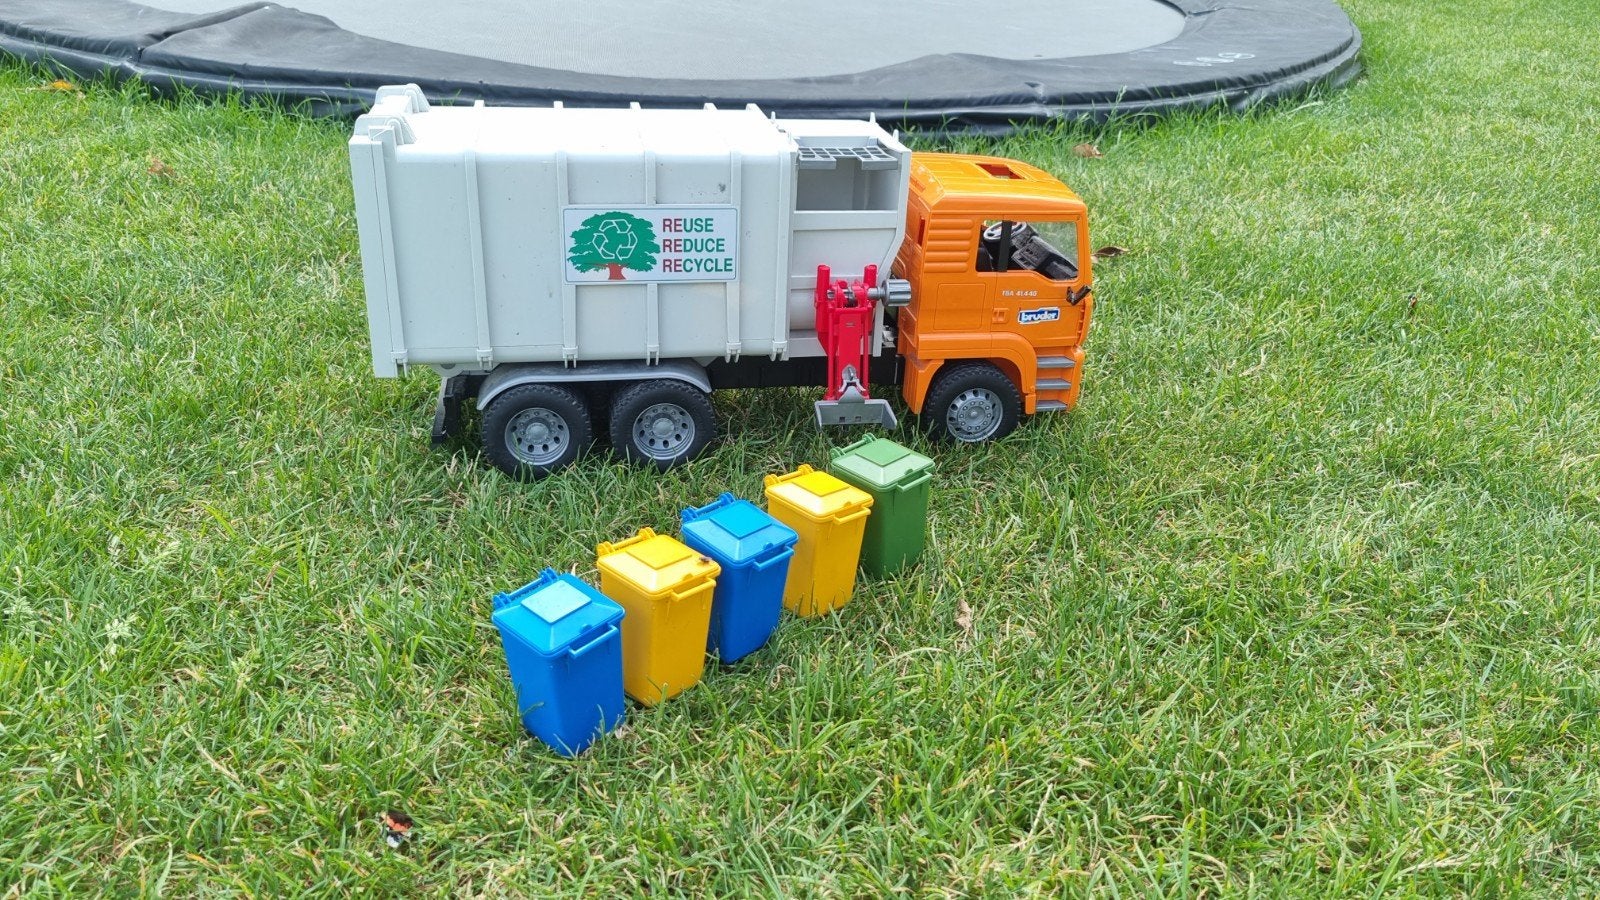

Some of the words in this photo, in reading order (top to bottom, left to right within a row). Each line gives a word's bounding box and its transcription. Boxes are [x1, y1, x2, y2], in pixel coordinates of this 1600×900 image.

[662, 217, 714, 233] REUSE
[662, 237, 725, 253] REDUCE
[662, 257, 733, 273] RECYCLE
[1021, 310, 1057, 322] bruder
